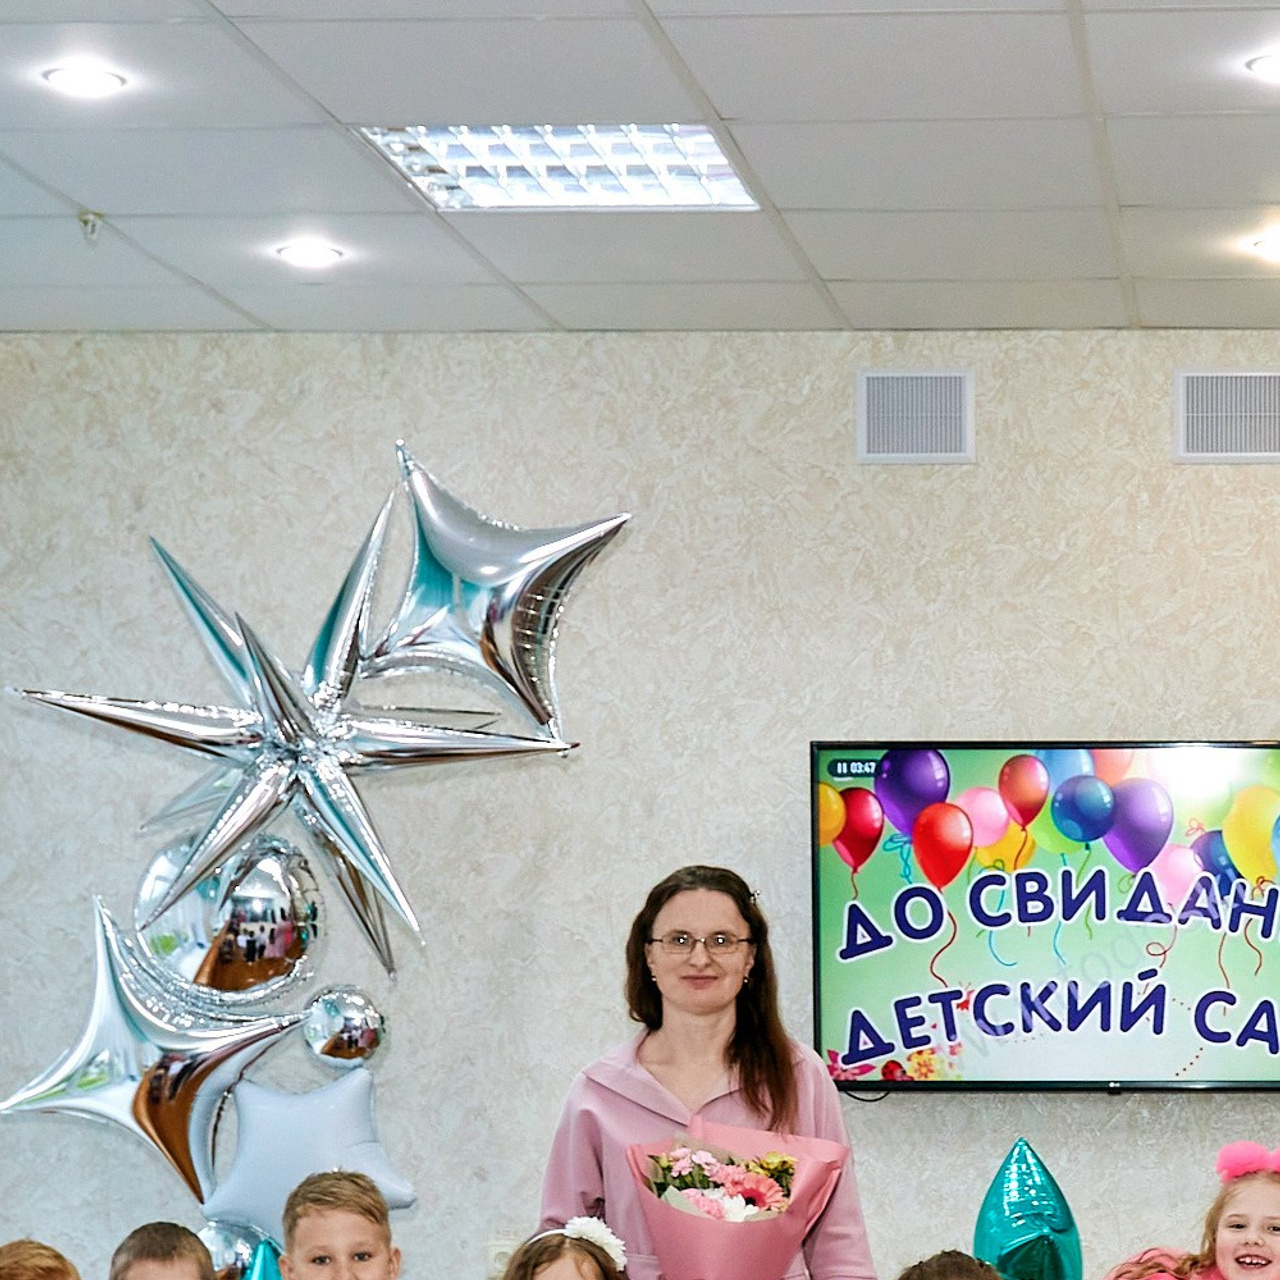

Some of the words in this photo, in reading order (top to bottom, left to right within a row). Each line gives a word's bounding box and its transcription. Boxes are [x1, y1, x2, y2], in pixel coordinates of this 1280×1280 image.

[850, 761, 876, 774] 03:47
[839, 888, 943, 960] ДО
[842, 969, 1167, 1065] ДЕТСКИЙ
